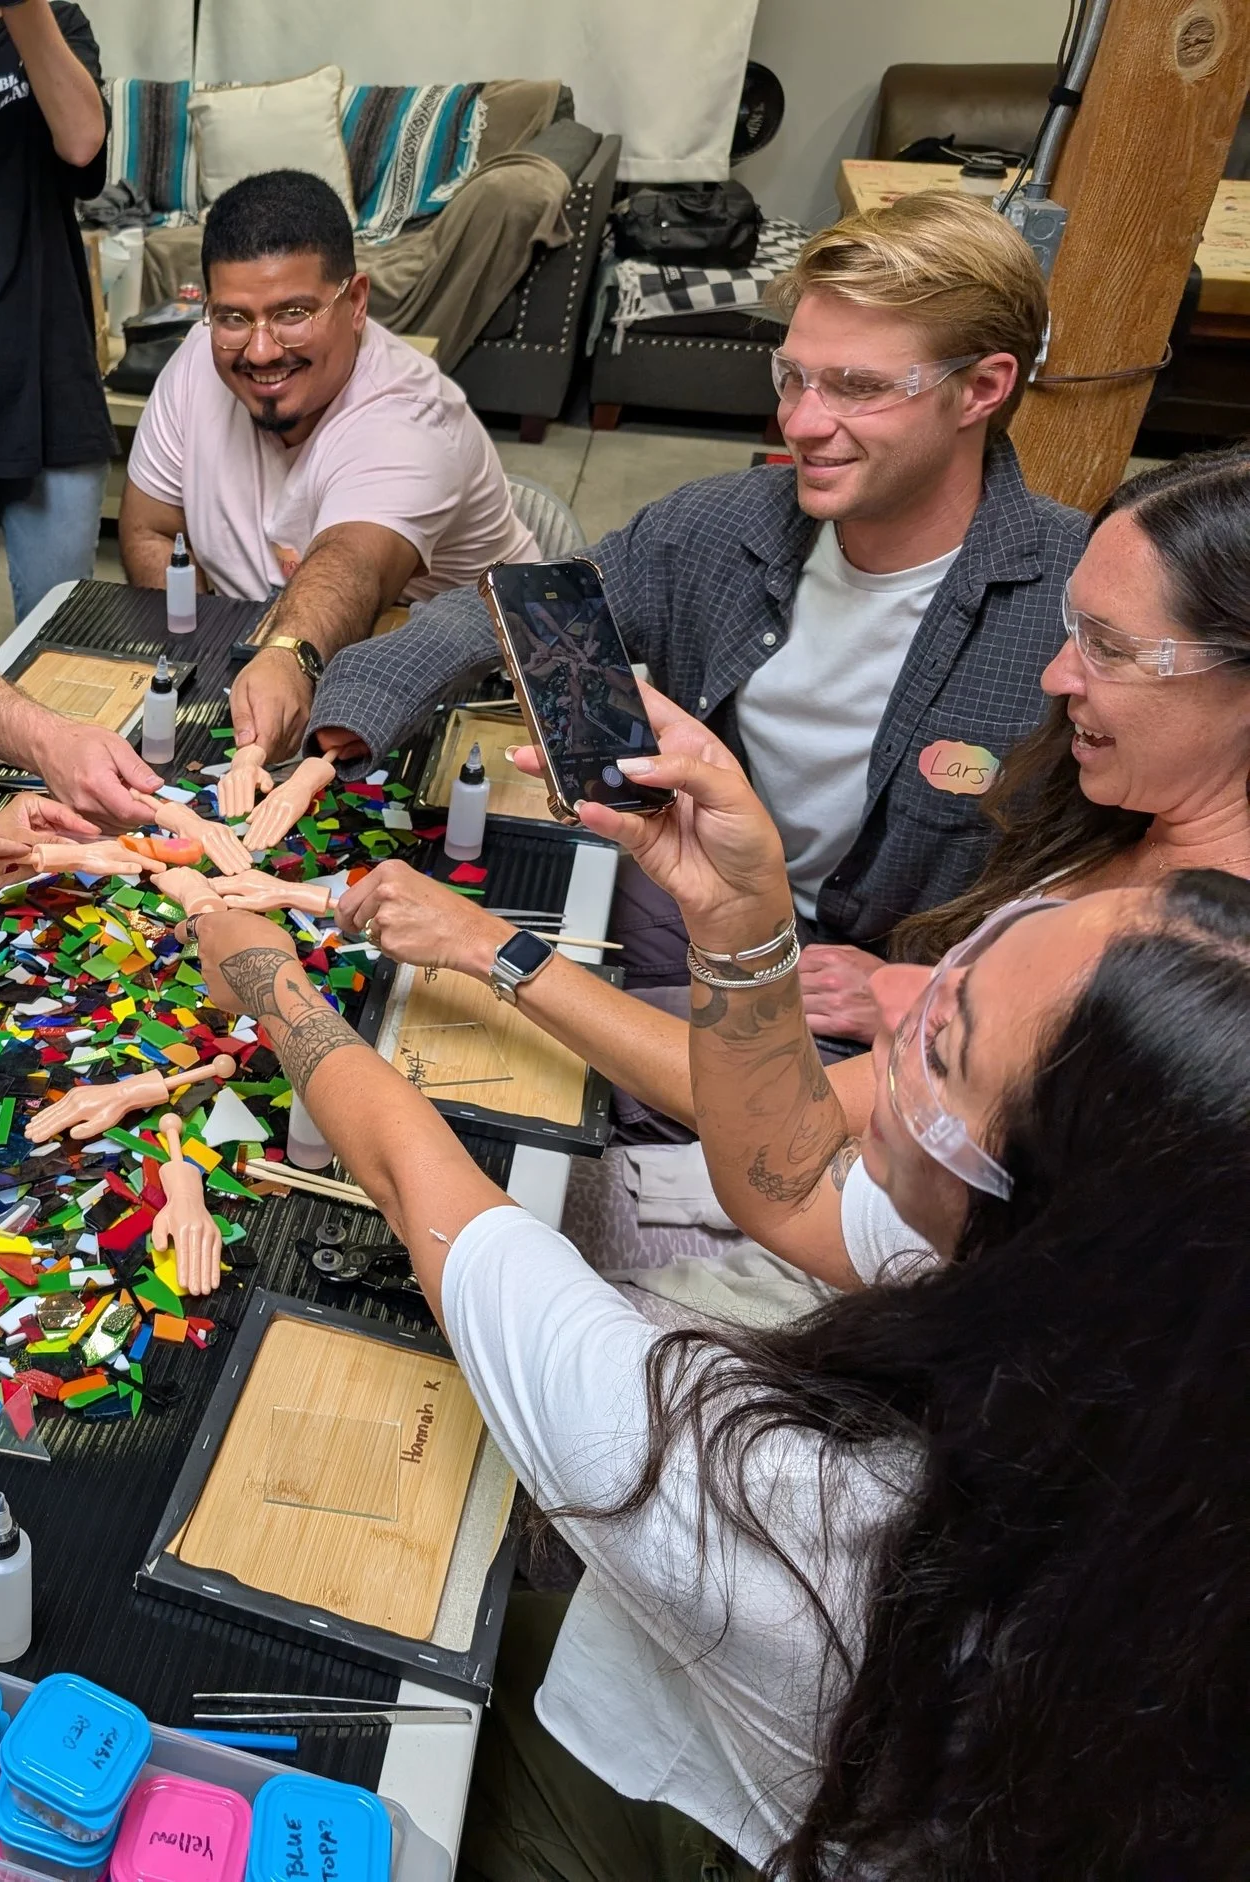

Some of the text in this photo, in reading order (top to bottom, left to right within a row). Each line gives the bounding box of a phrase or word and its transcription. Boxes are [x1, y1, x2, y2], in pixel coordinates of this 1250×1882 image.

[930, 750, 990, 784] Lars
[406, 1048, 437, 1091] RACY
[399, 1380, 442, 1465] Hannah K
[61, 1714, 92, 1751] RED
[148, 1831, 214, 1862] Yellow
[283, 1812, 310, 1880] BLUE
